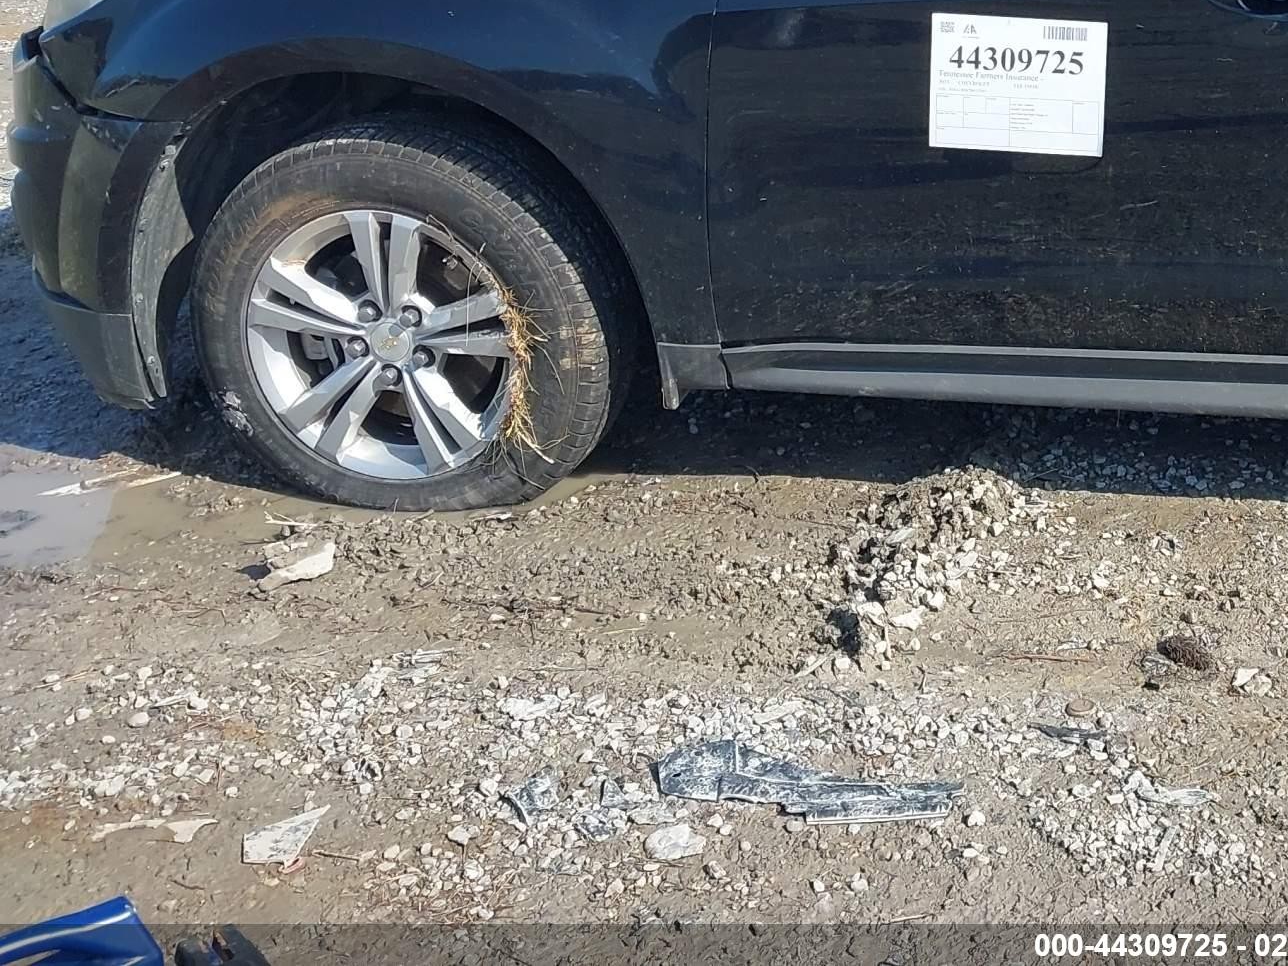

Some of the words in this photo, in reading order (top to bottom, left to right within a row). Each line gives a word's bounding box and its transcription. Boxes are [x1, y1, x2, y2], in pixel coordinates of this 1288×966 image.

[949, 45, 1084, 75] 44309725
[939, 69, 974, 80] Tennessee
[975, 71, 1003, 81] Farmers
[1005, 73, 1039, 82] Insurance
